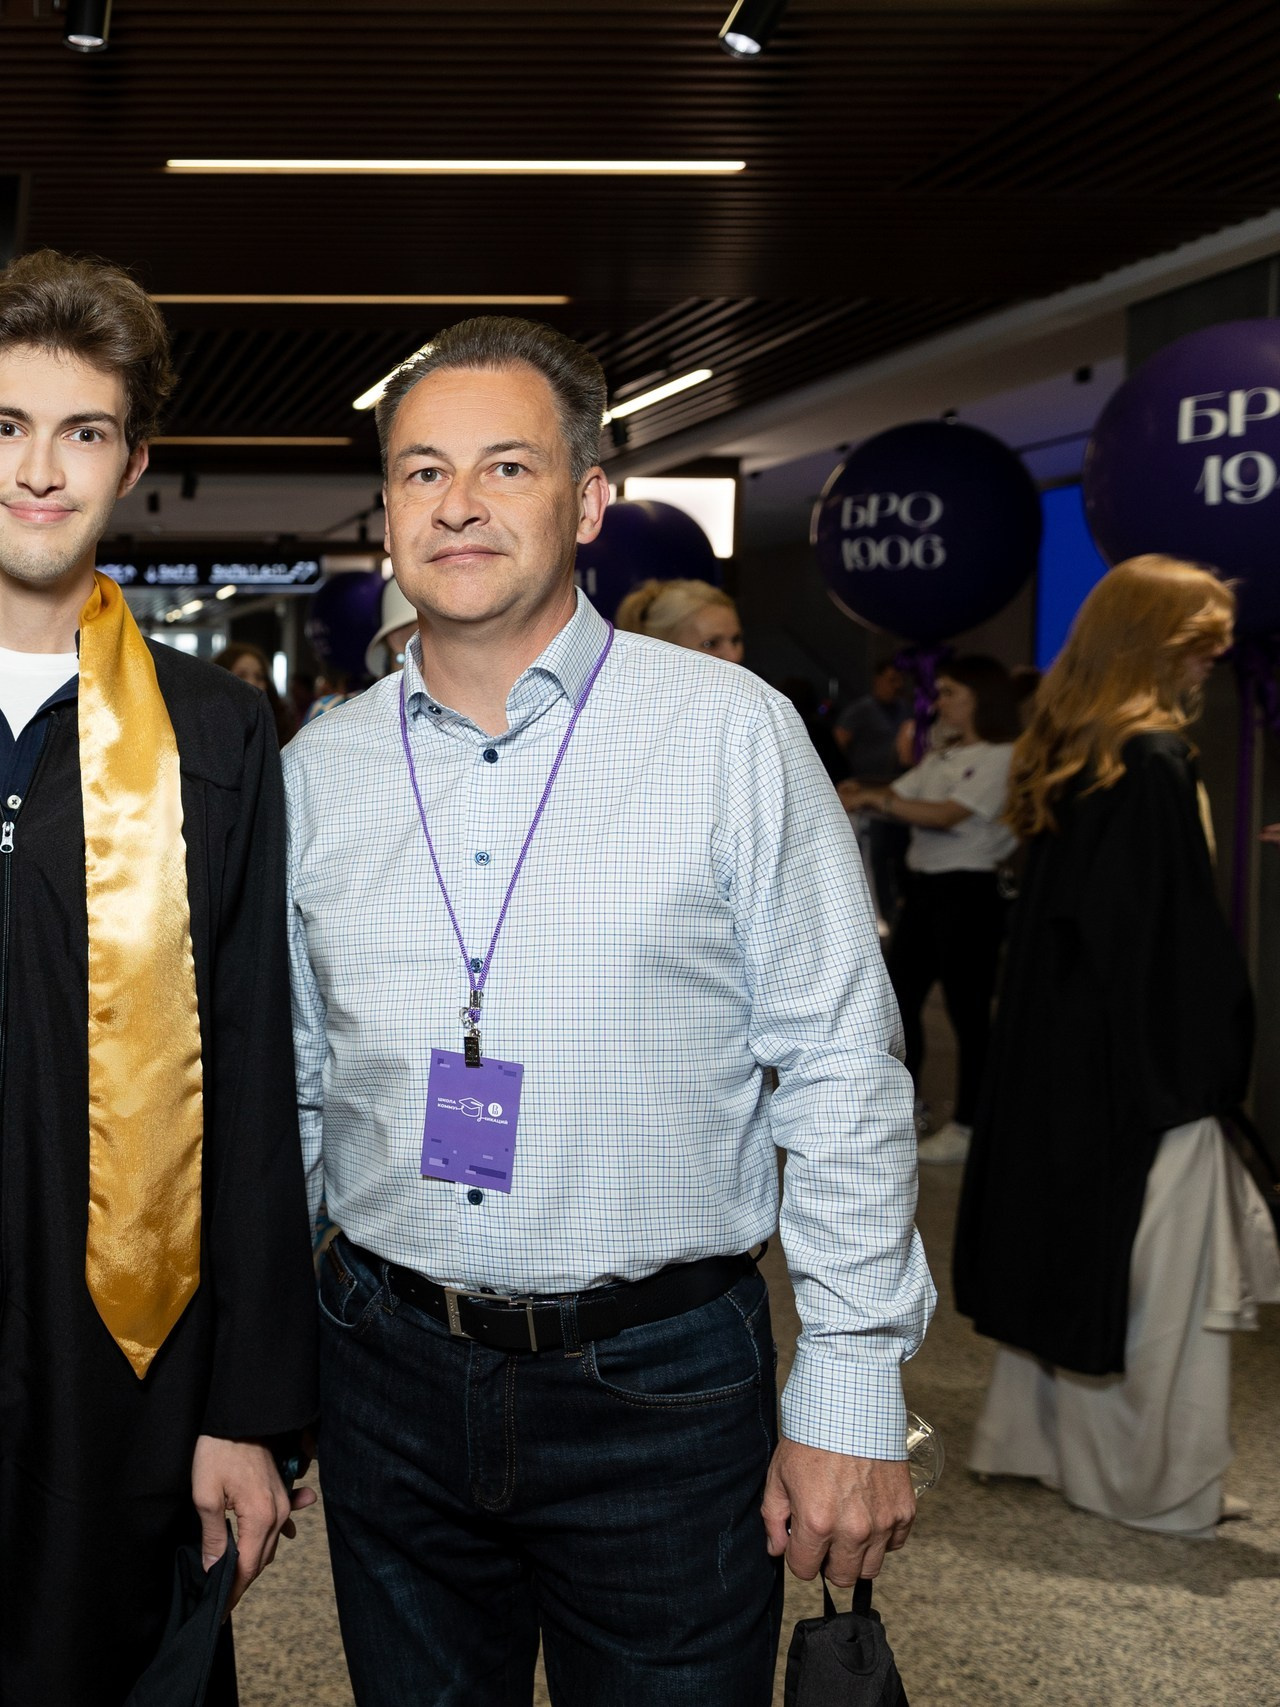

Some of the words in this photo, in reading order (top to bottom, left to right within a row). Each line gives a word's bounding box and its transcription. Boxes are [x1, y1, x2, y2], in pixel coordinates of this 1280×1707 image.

[1177, 386, 1280, 445] БР
[1194, 450, 1280, 506] 19
[840, 490, 945, 531] БРО
[841, 535, 947, 573] 1906
[437, 1097, 457, 1105] ШКОЛА
